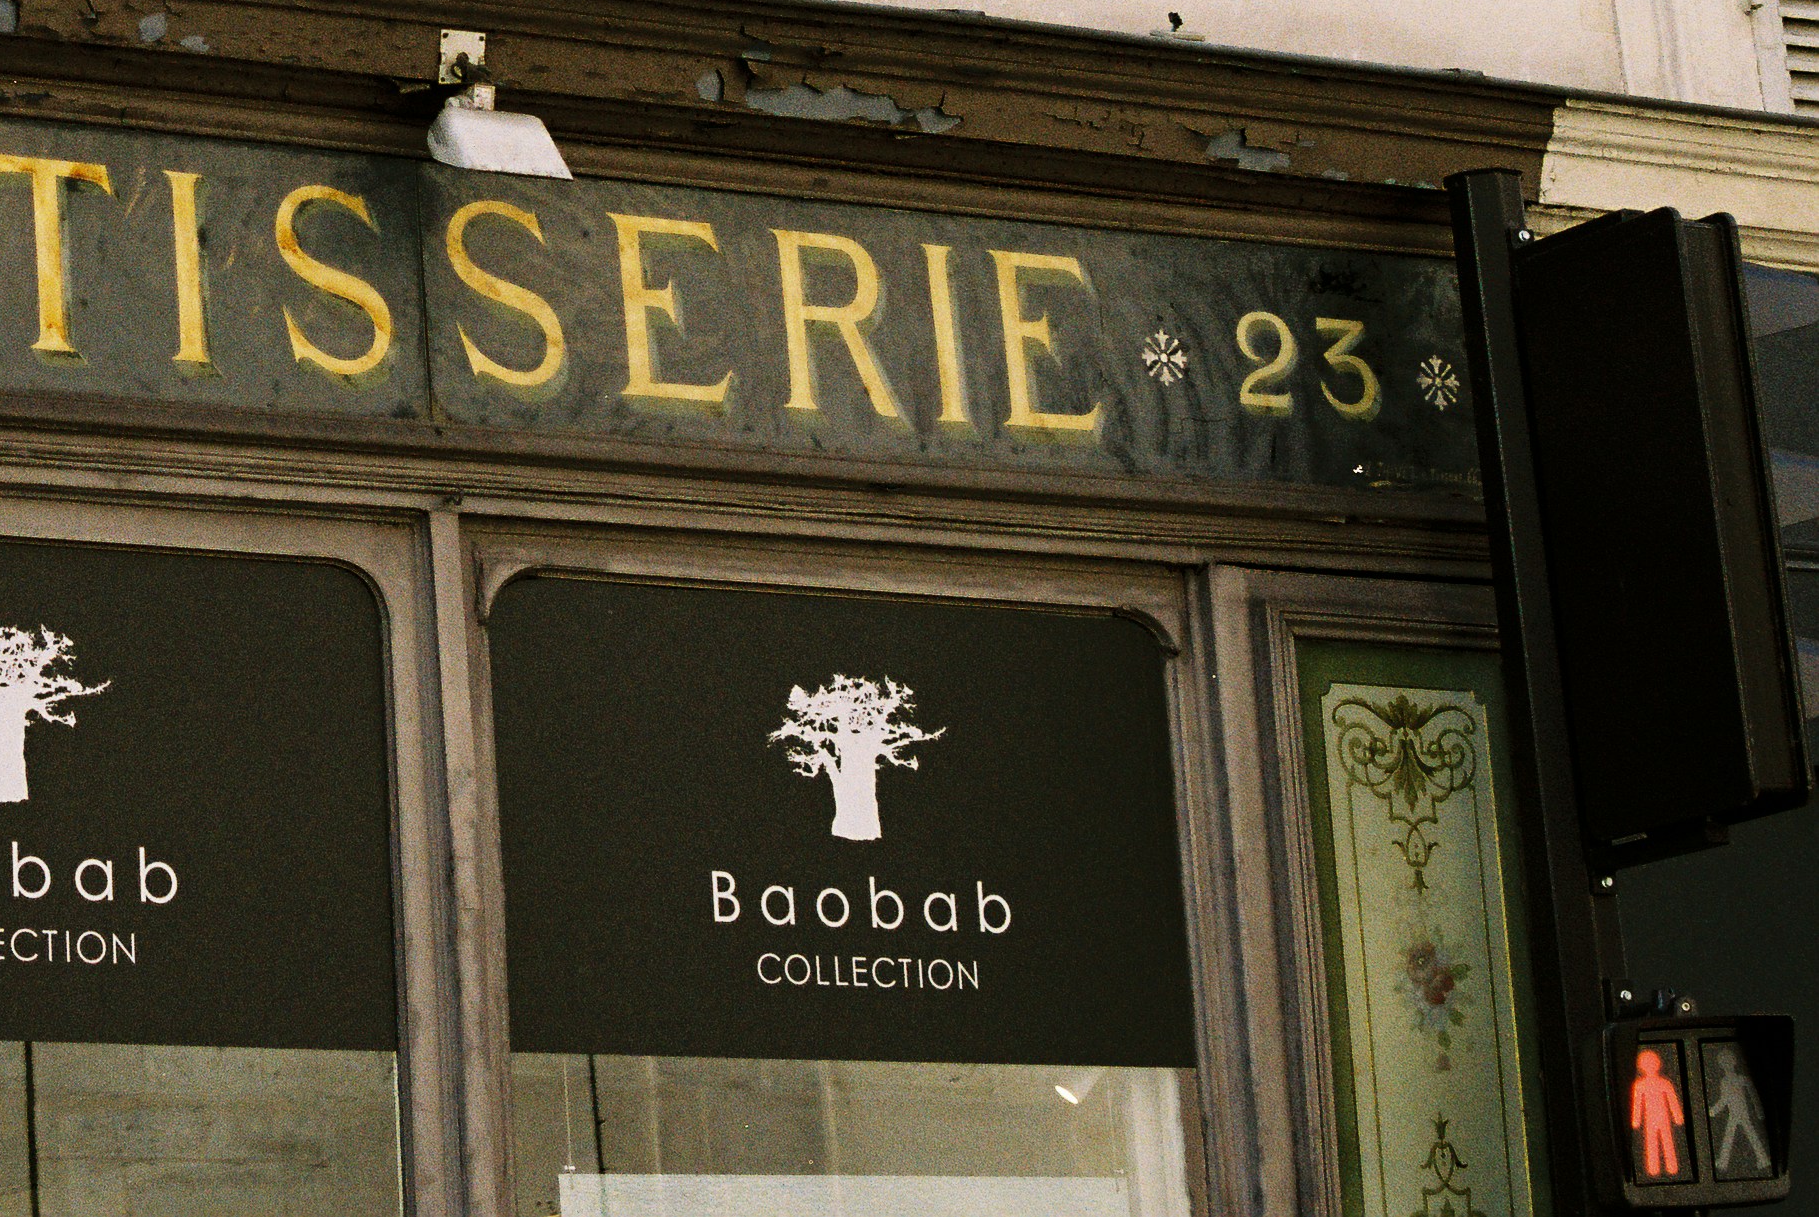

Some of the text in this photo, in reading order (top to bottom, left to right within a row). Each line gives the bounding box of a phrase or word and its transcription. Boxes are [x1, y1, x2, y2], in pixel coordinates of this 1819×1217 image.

[1235, 310, 1381, 423] 23
[710, 870, 1012, 935] Baobab
[756, 952, 980, 991] COLLECTION
